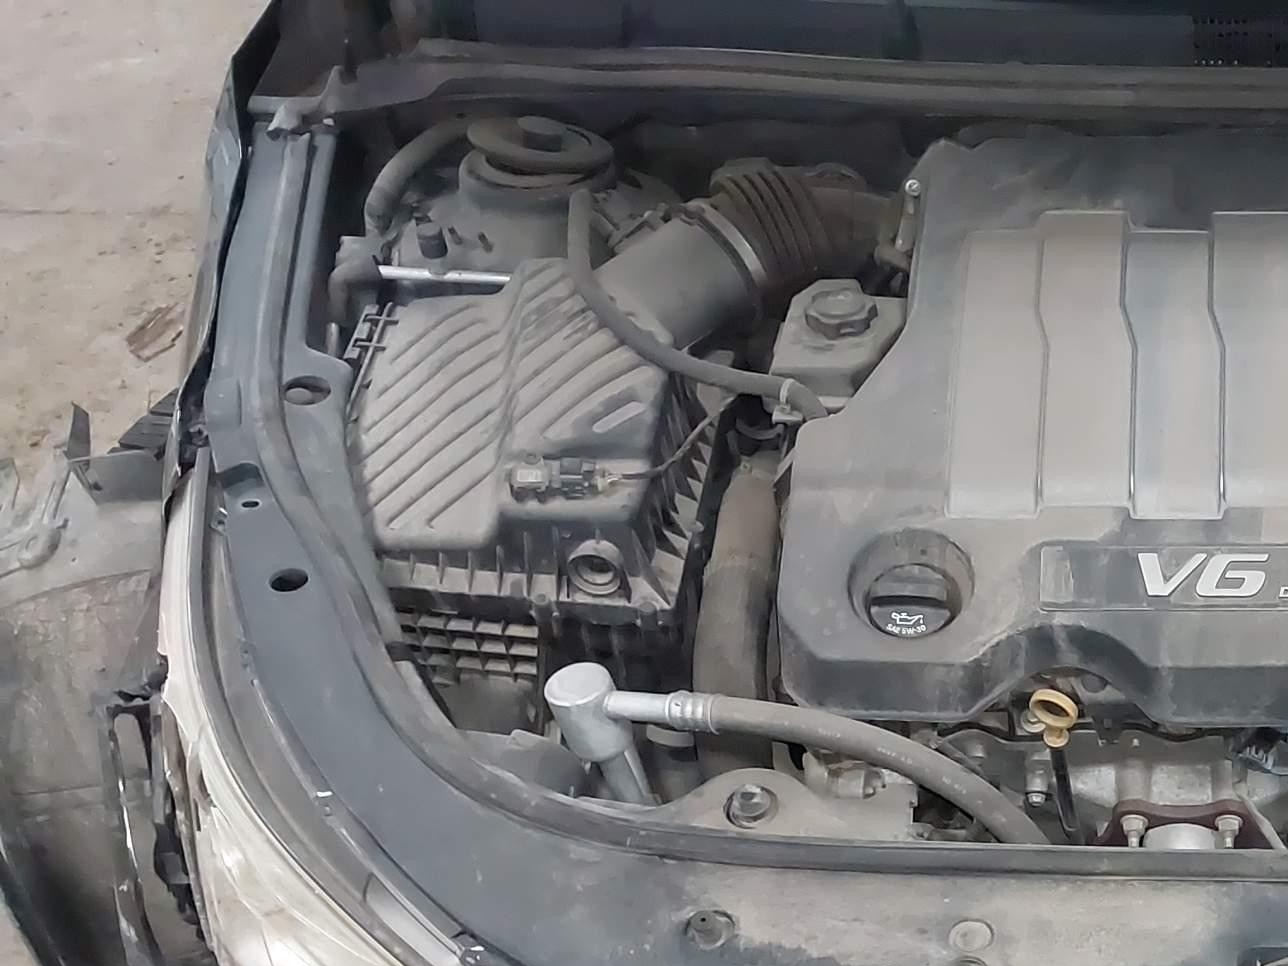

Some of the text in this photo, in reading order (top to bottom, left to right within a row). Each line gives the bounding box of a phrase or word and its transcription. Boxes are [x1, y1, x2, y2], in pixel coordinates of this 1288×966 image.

[1136, 552, 1270, 598] V6
[886, 623, 927, 635] SAE 5W-30
